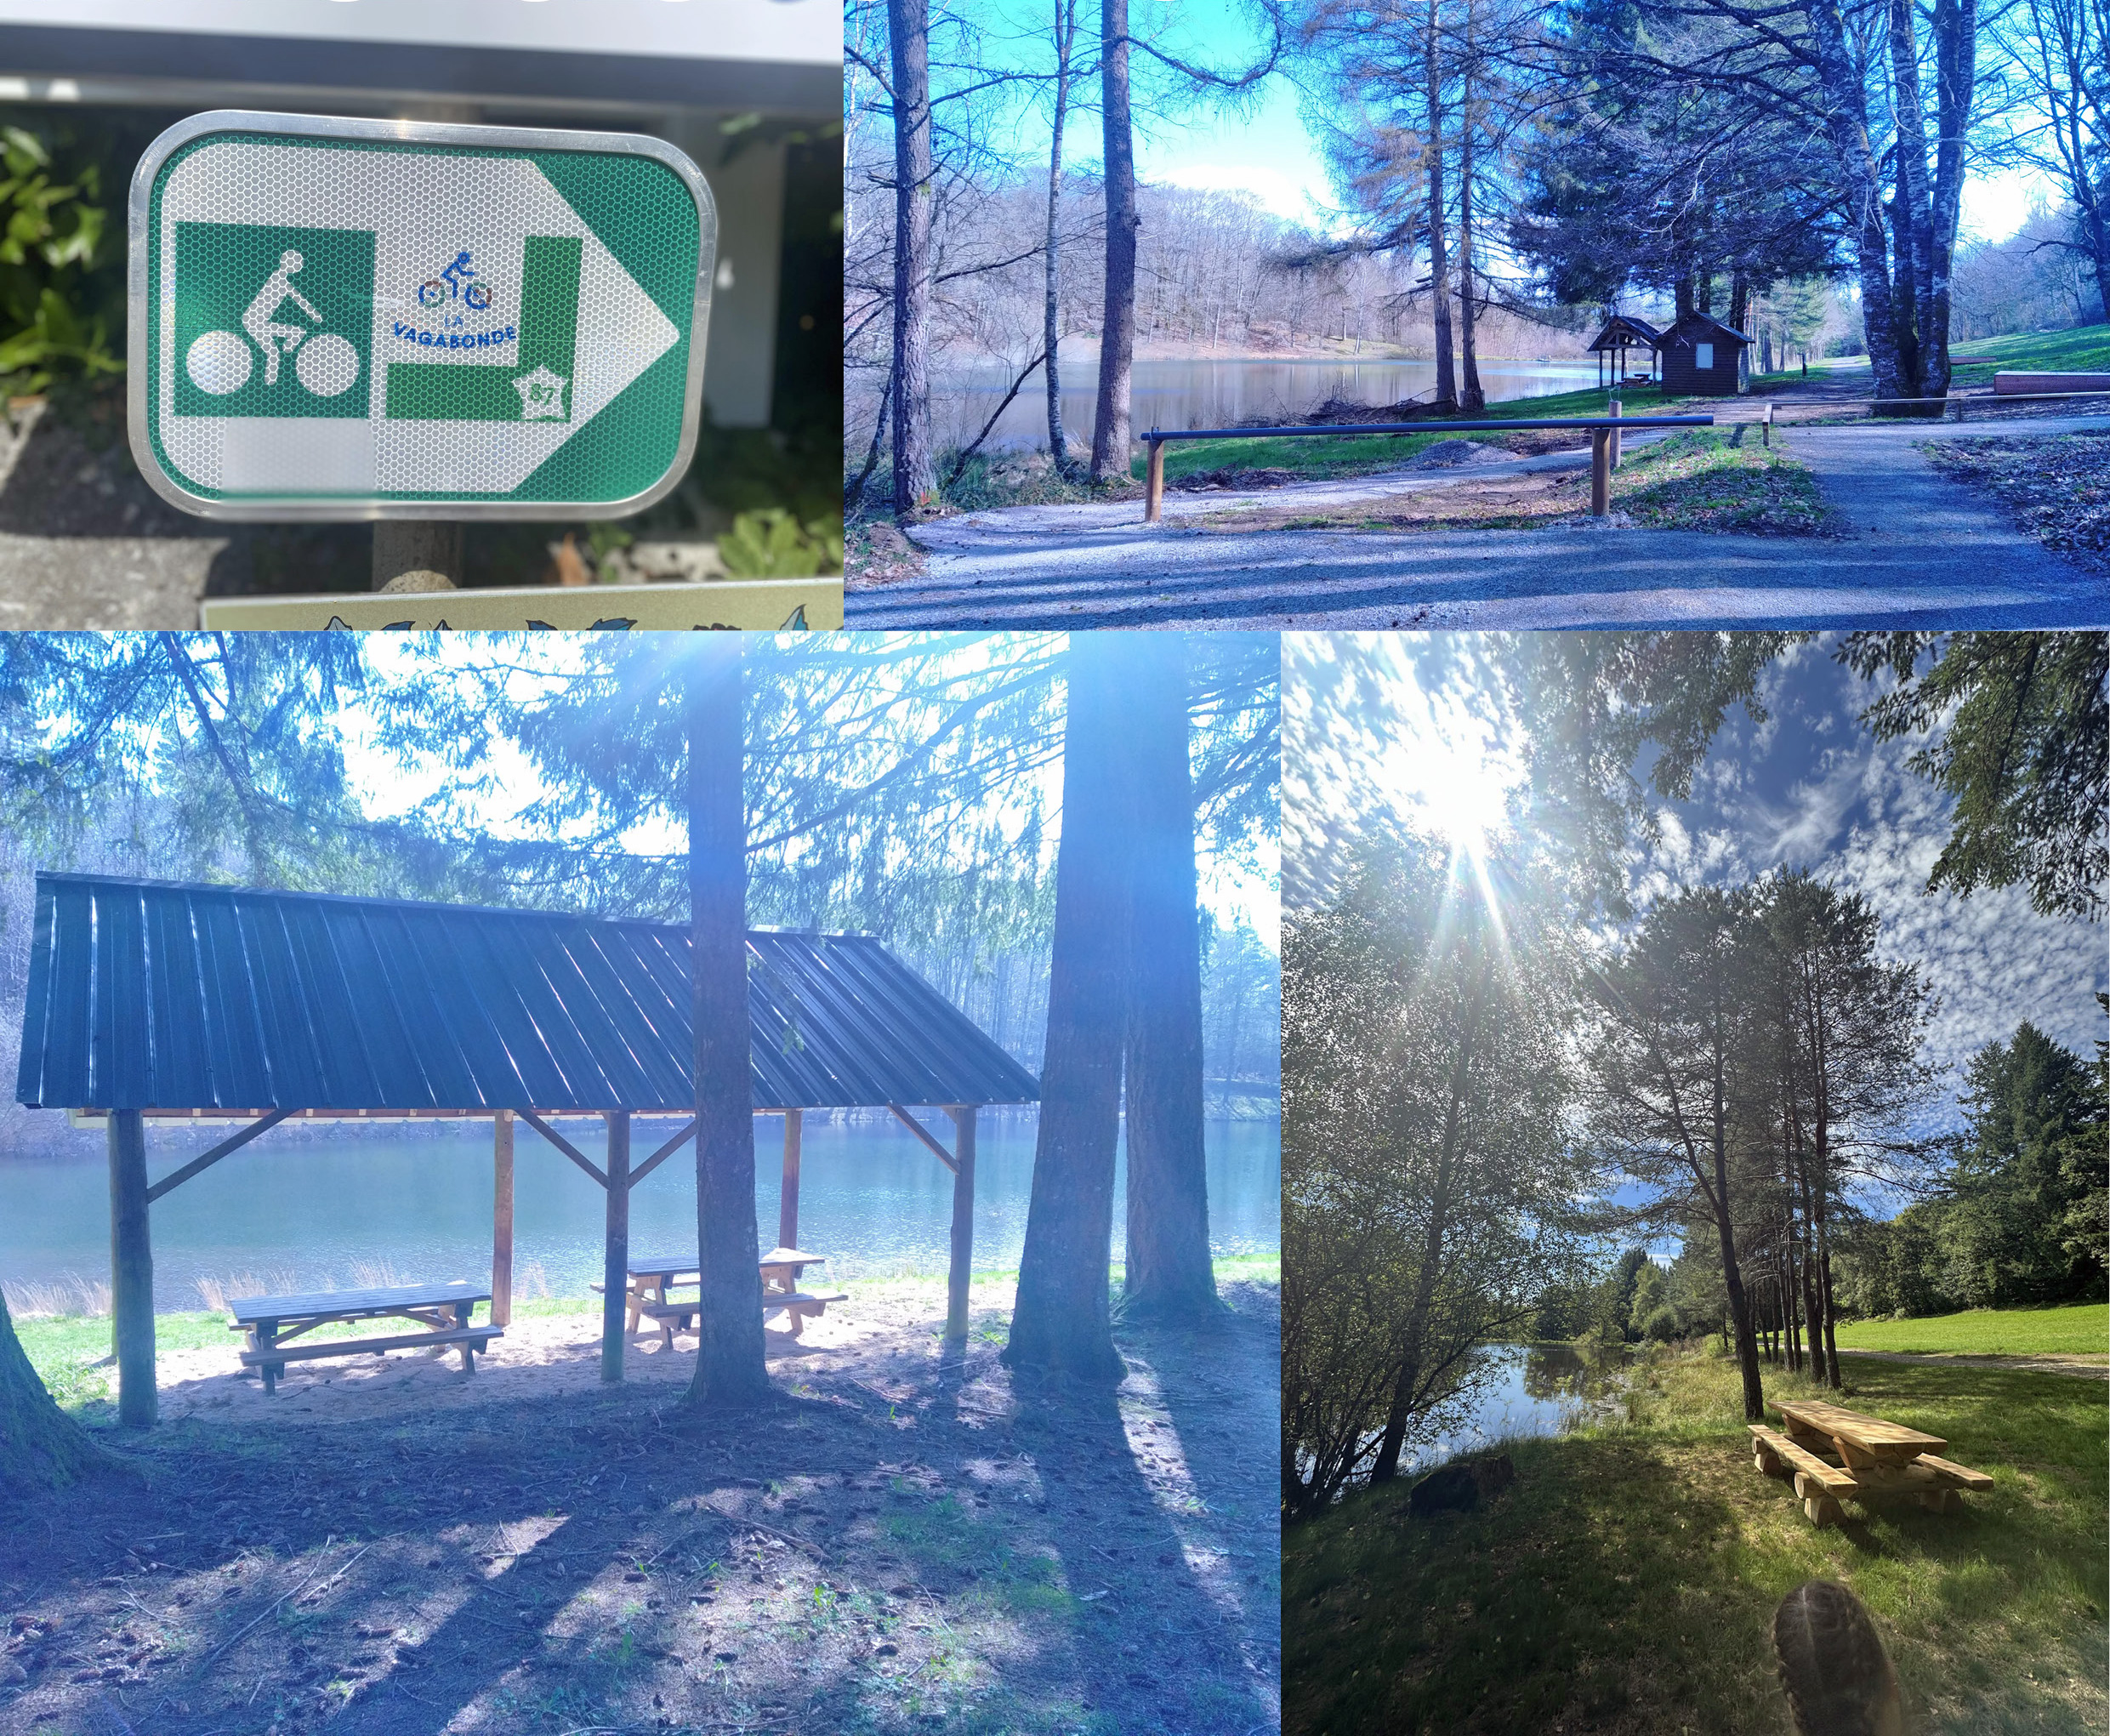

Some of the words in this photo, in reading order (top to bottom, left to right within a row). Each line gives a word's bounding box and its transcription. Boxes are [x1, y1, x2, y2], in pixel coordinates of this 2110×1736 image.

[445, 315, 464, 327] LA
[394, 322, 517, 349] VAGABONDE
[530, 383, 555, 406] 87
